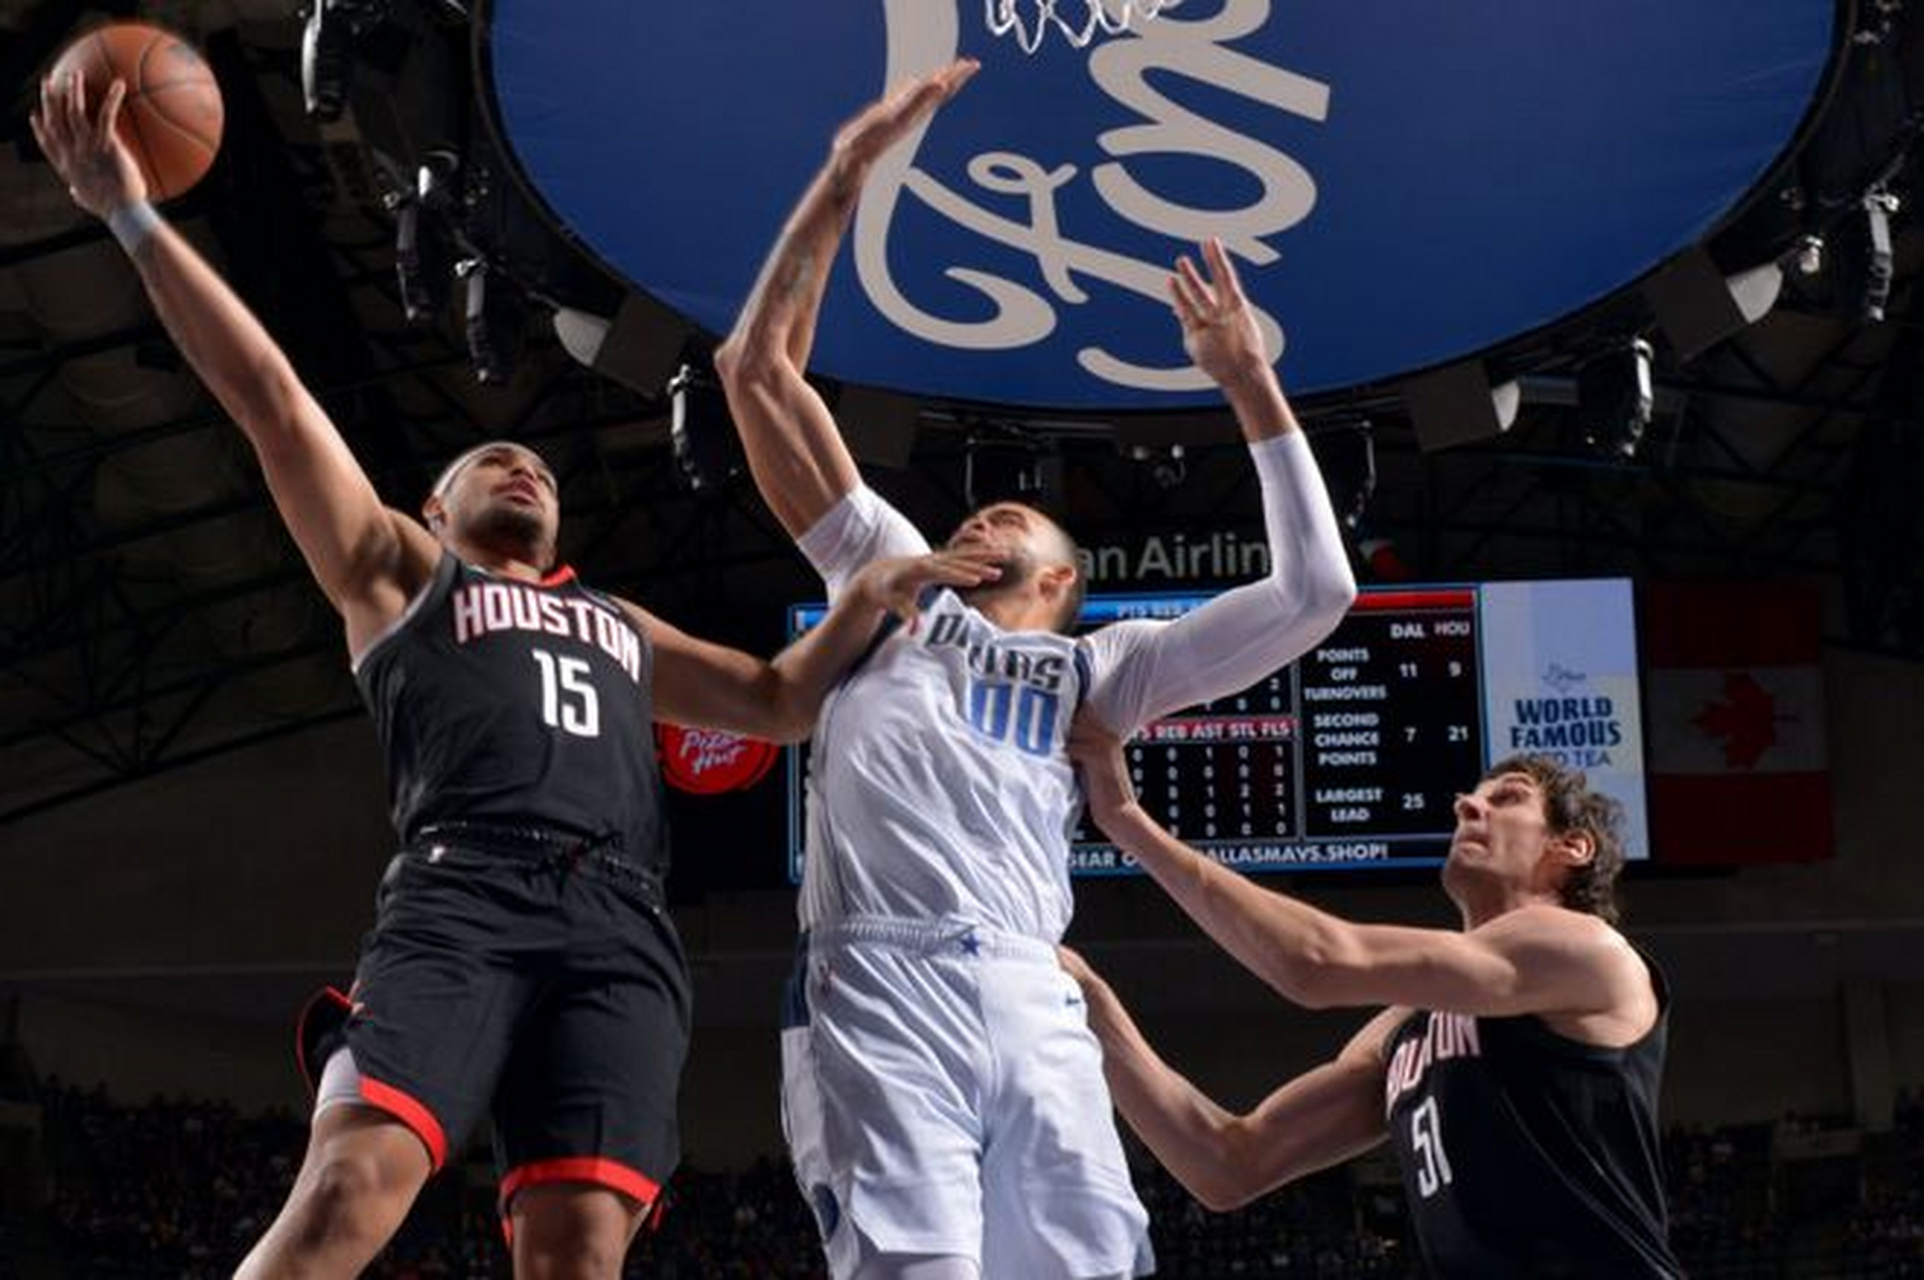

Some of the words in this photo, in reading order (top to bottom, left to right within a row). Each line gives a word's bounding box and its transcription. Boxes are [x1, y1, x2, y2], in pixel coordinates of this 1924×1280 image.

[1136, 531, 1271, 580] Airlin
[453, 583, 641, 684] HOUSTON
[1390, 623, 1424, 638] DAL
[1434, 621, 1470, 635] HOU
[1317, 649, 1369, 662] POINTS
[1331, 667, 1358, 680] OFF
[1400, 662, 1418, 677] 11
[532, 649, 600, 737] 15
[1304, 685, 1386, 701] TURNOVERS
[968, 679, 1059, 758] 00
[1515, 697, 1613, 724] WORLD
[1314, 713, 1380, 728] SECOND
[1192, 723, 1223, 740] AST
[1229, 722, 1257, 738] STL
[1261, 720, 1290, 737] FLS
[1404, 727, 1416, 742] 7
[1448, 725, 1468, 741] 21
[1510, 719, 1622, 748] FAMOUS
[1314, 731, 1380, 747] CHANCE
[1318, 751, 1377, 765] POINTS
[1573, 749, 1612, 768] TEA
[1316, 788, 1383, 803] LARGEST
[1403, 793, 1424, 809] 25
[1331, 808, 1370, 822] LEAD
[1412, 1095, 1453, 1199] 51
